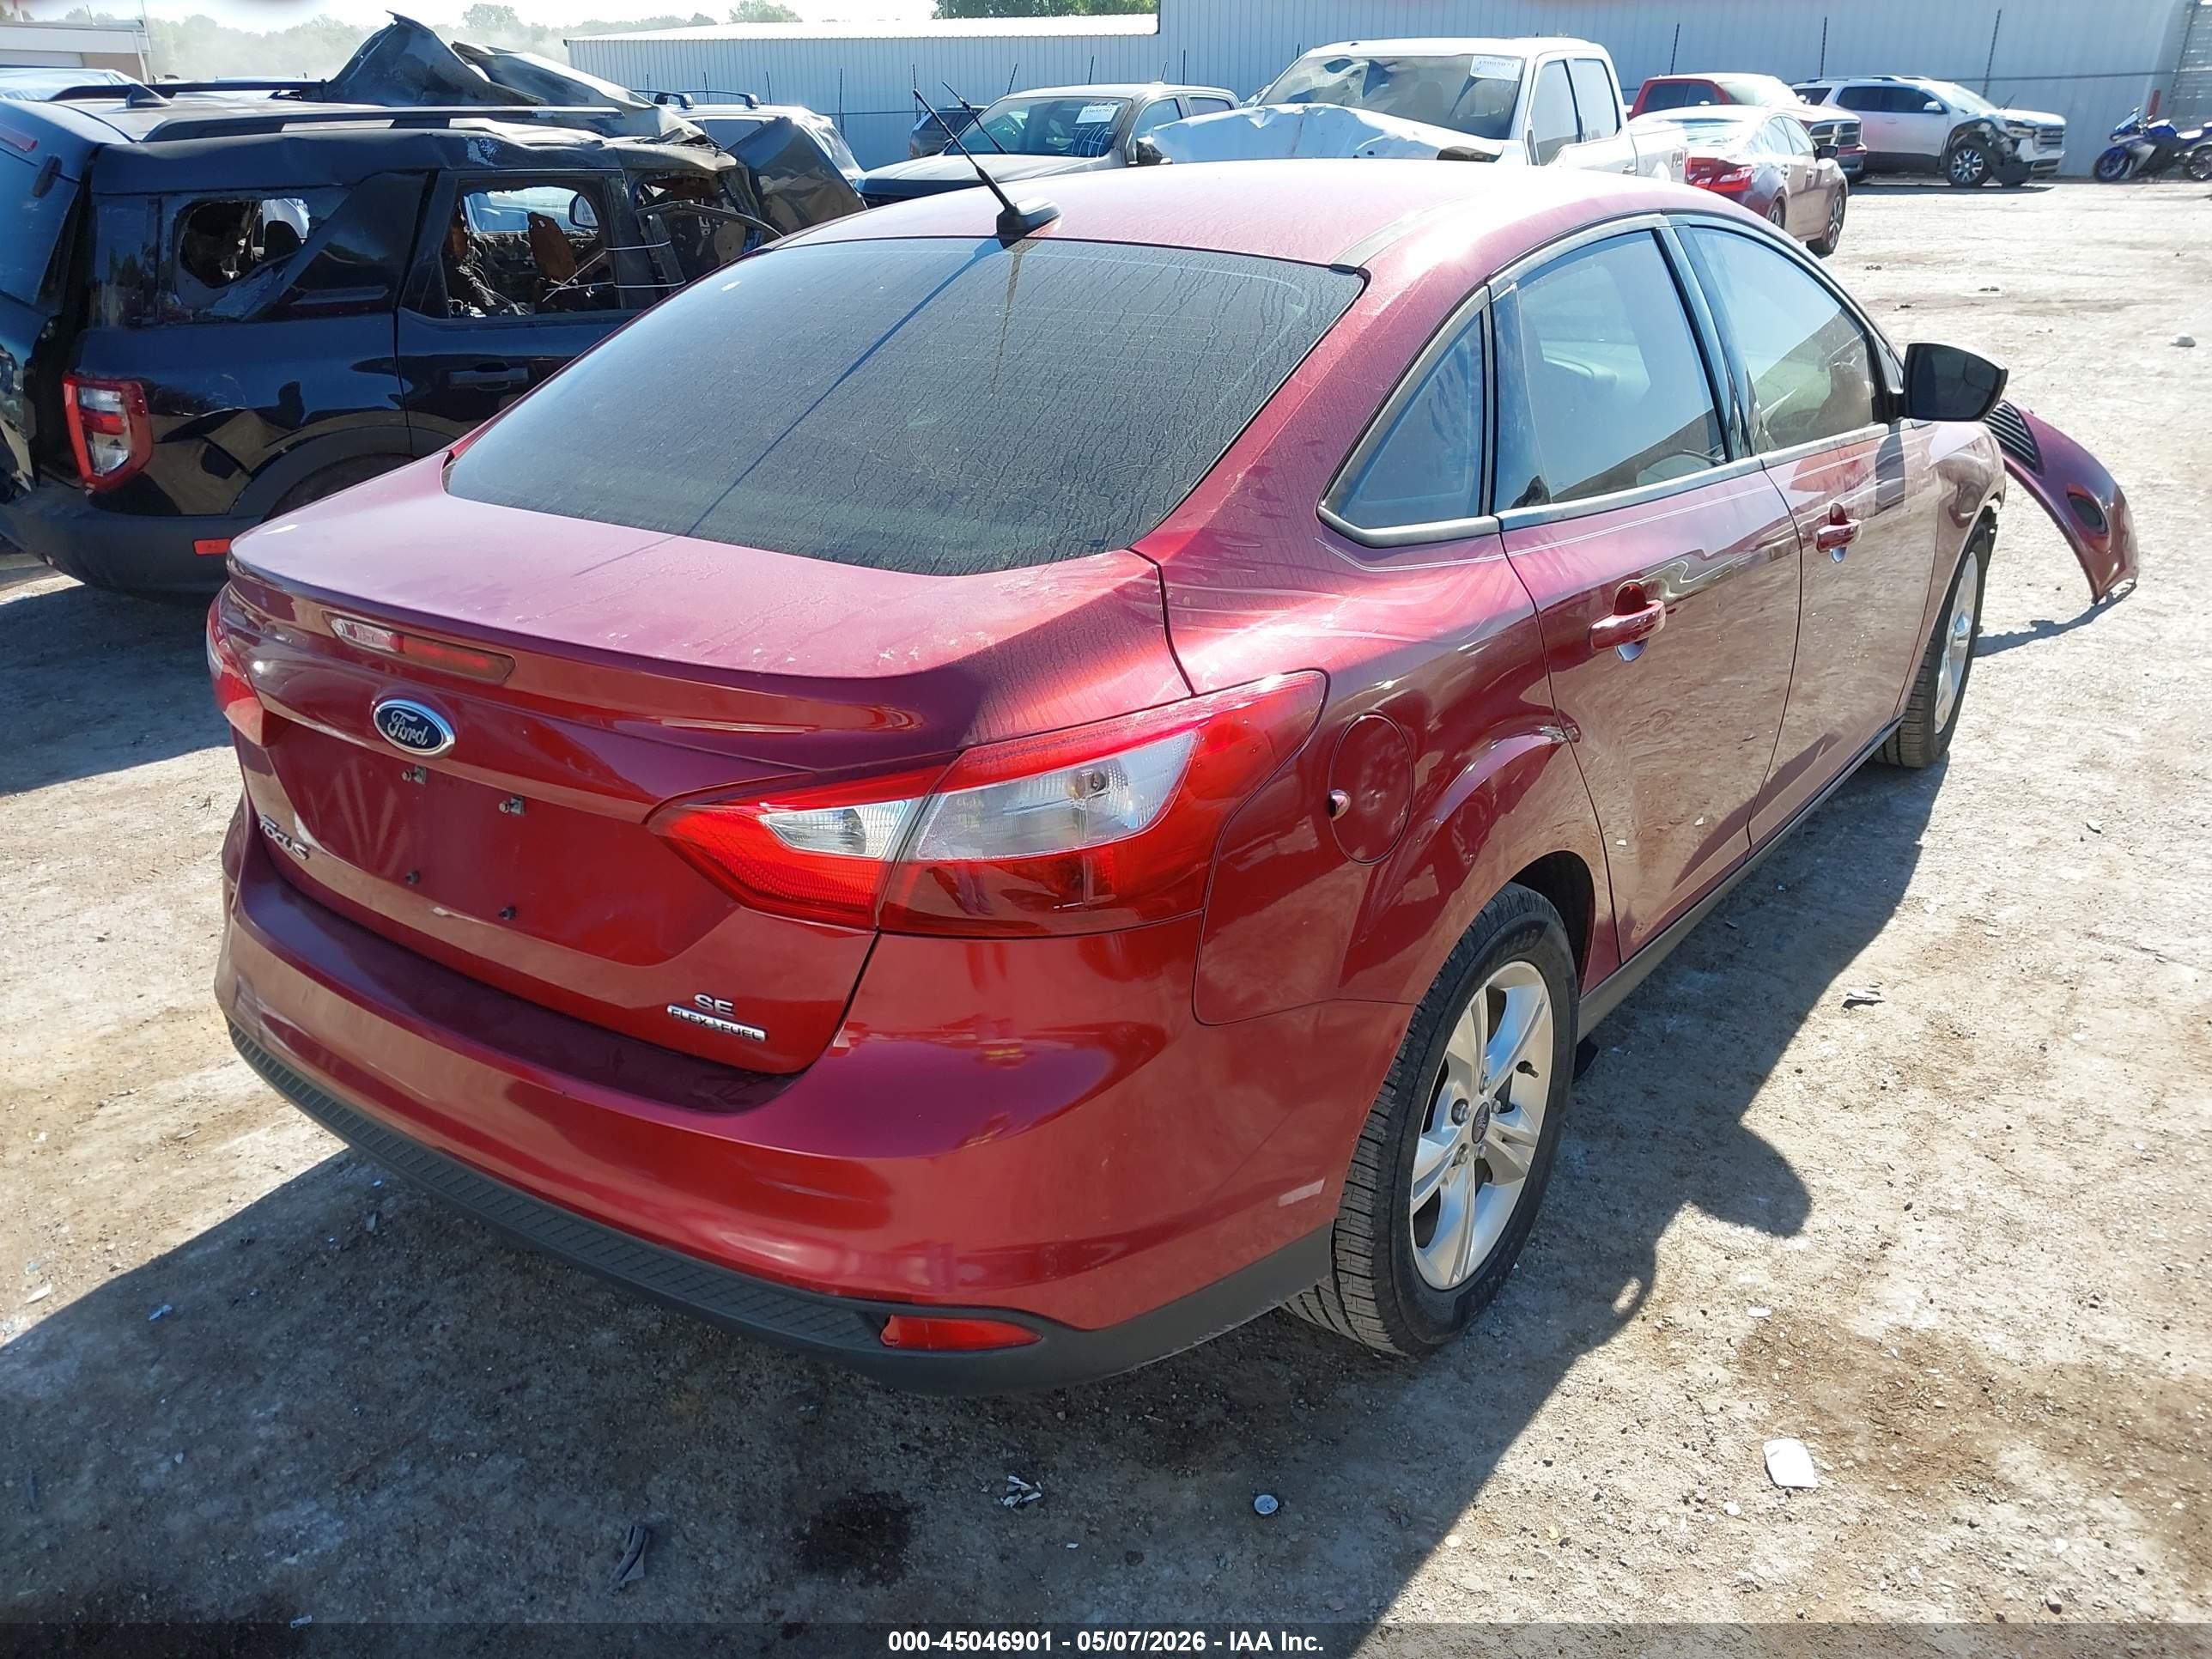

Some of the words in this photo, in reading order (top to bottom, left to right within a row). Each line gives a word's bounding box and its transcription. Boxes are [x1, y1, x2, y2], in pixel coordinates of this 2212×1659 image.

[387, 709, 428, 745] Ford
[694, 994, 734, 1017] SE
[671, 1007, 708, 1027] FLEX
[721, 1023, 763, 1042] FUEL
